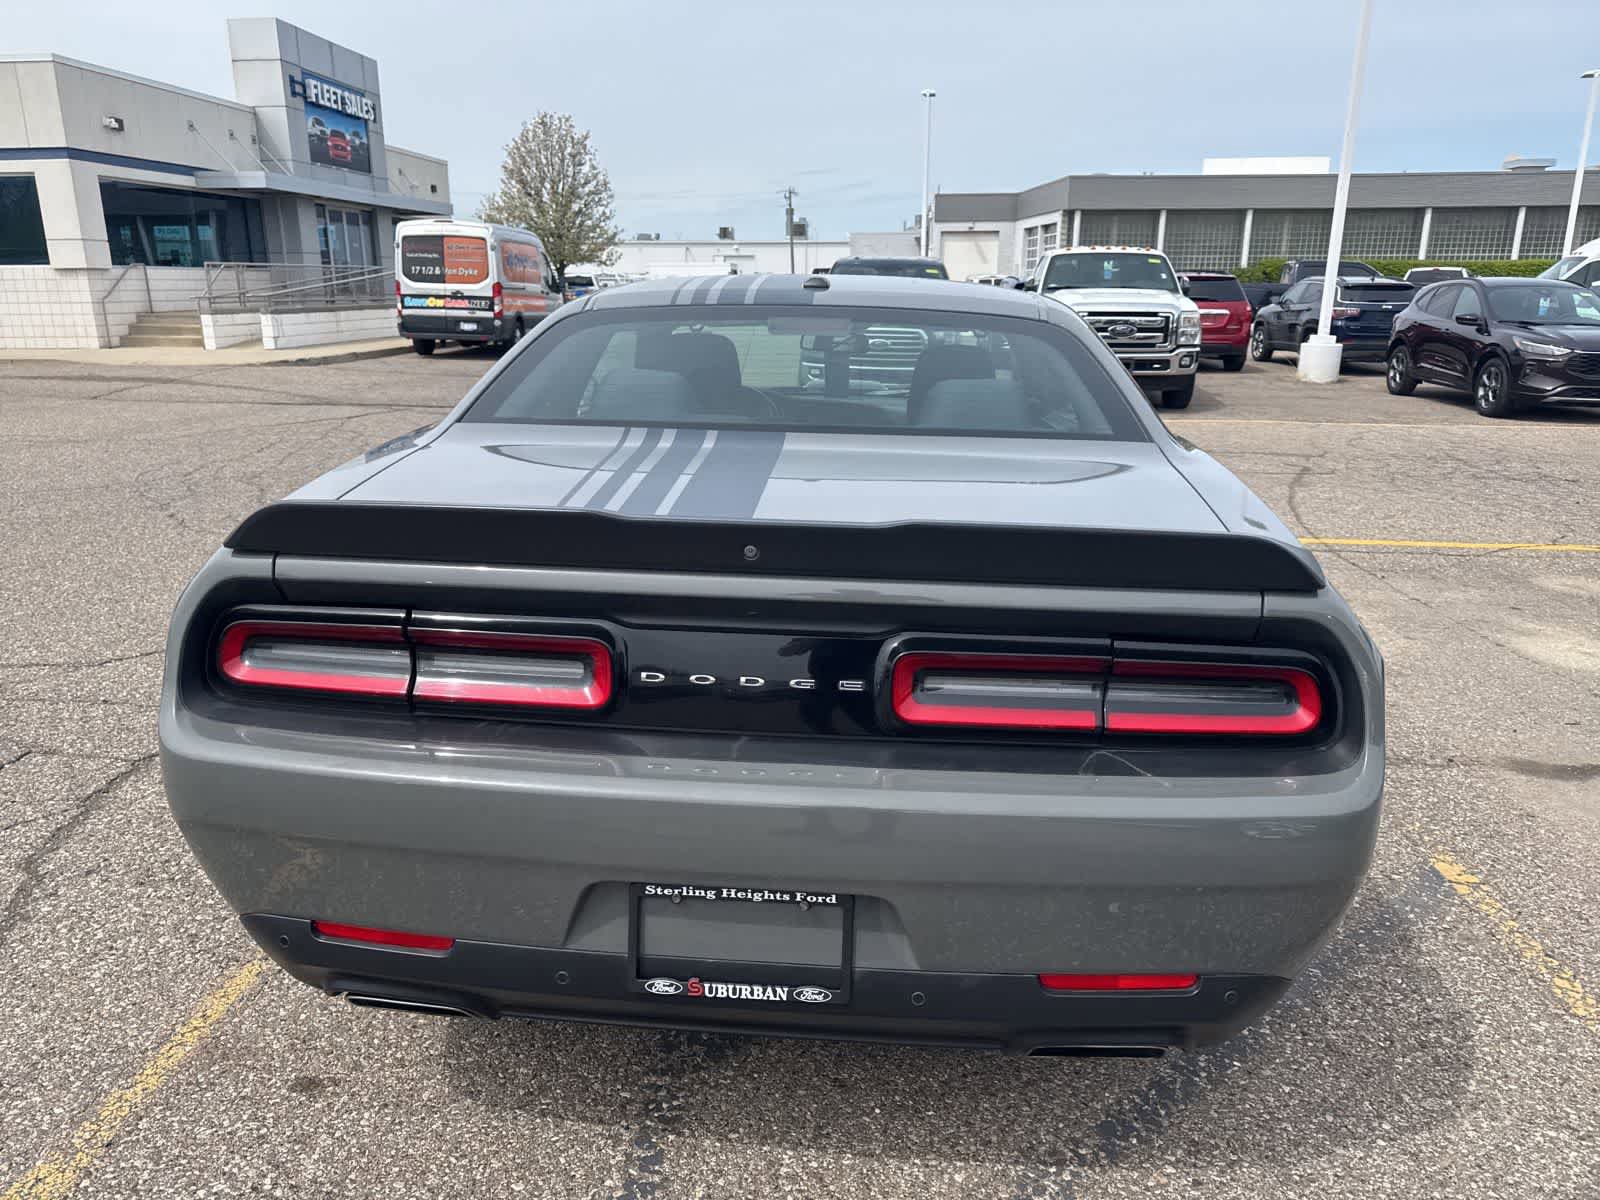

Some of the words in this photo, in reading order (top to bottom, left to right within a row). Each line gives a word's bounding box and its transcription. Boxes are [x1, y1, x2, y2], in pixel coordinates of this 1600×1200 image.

[306, 78, 343, 111] FLEET
[343, 91, 375, 121] SALES
[434, 267, 441, 275] &
[458, 267, 479, 277] Dyke
[640, 671, 865, 691] DODGE
[645, 885, 716, 899] Sterling
[721, 888, 790, 902] Heights
[795, 892, 838, 904] Ford
[648, 979, 679, 993] Ford
[687, 977, 788, 1000] SUBURBAN
[797, 988, 828, 1002] Ford
